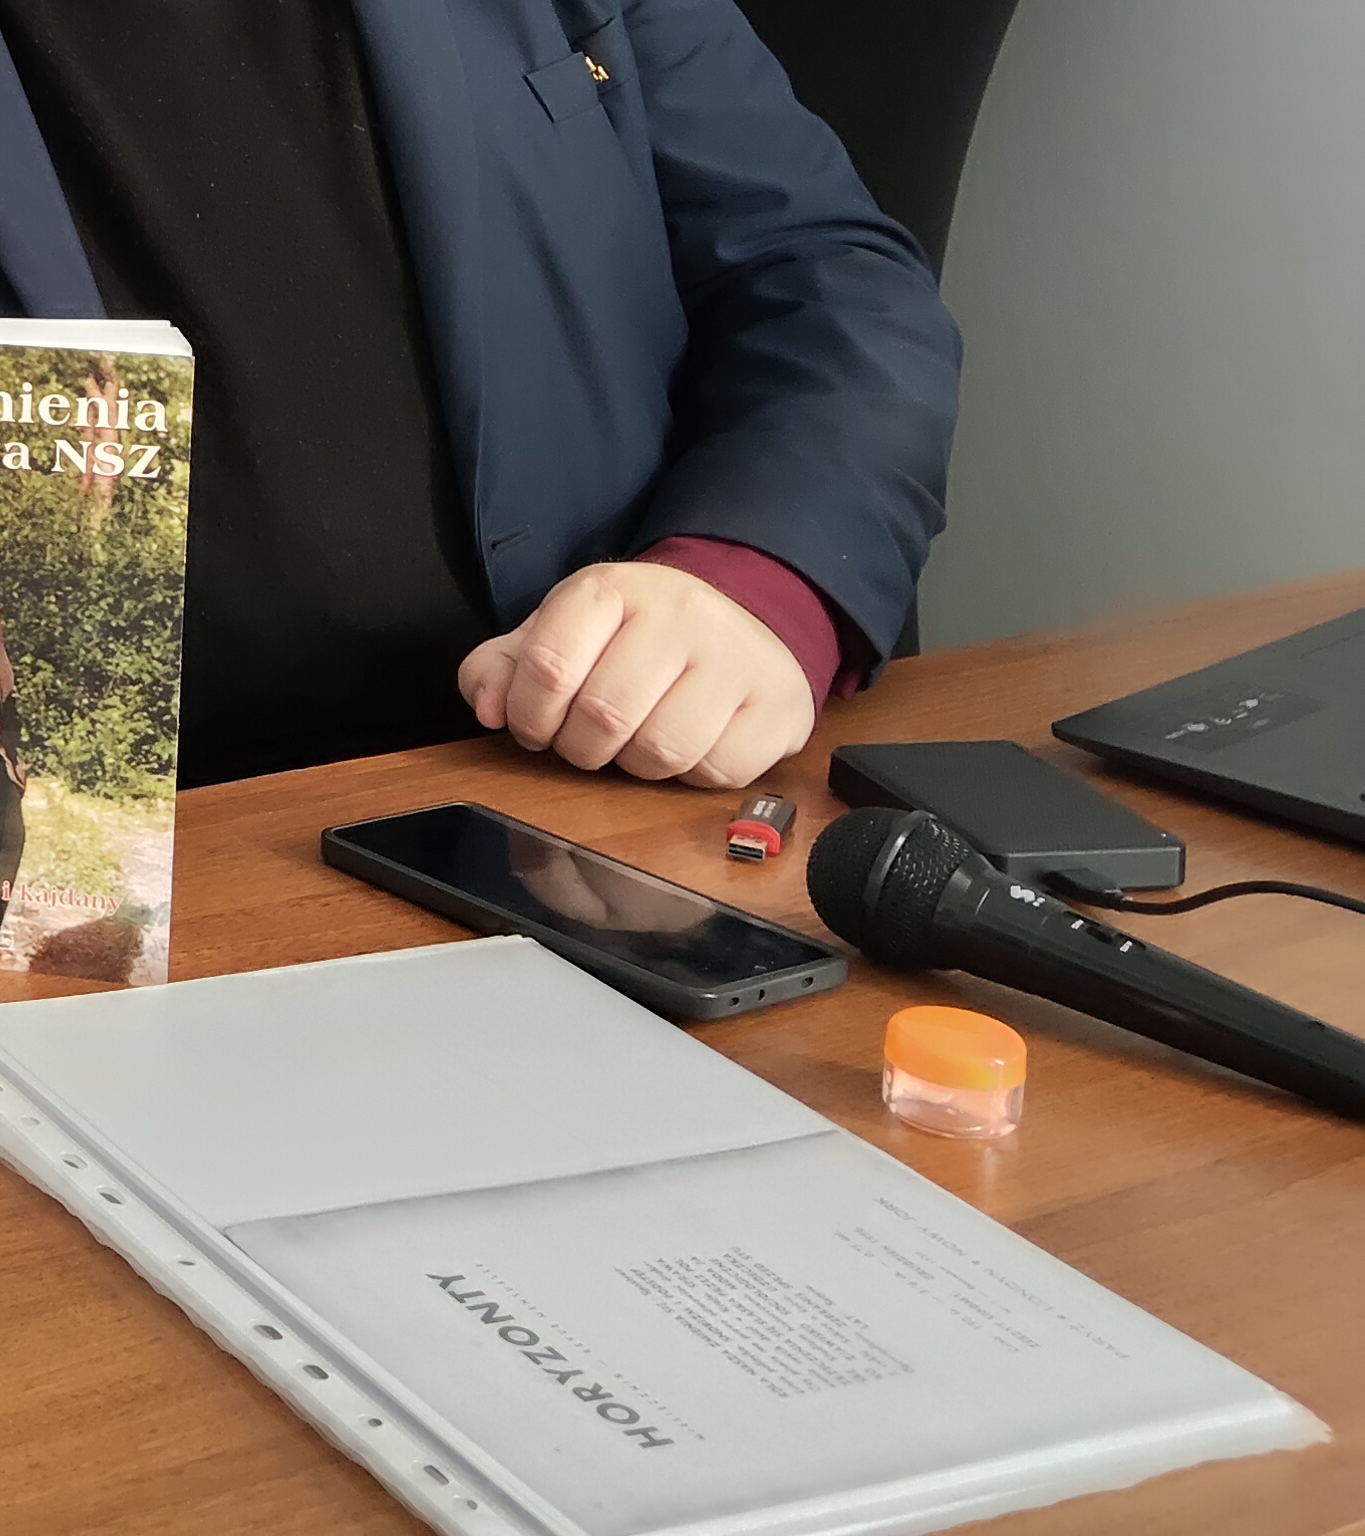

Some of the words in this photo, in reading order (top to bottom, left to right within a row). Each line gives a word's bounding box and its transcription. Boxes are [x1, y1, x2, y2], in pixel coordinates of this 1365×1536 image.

[51, 439, 161, 480] NSZ
[1, 880, 12, 902] i
[19, 884, 126, 917] kajdany
[426, 1271, 675, 1449] HORYZONTY
